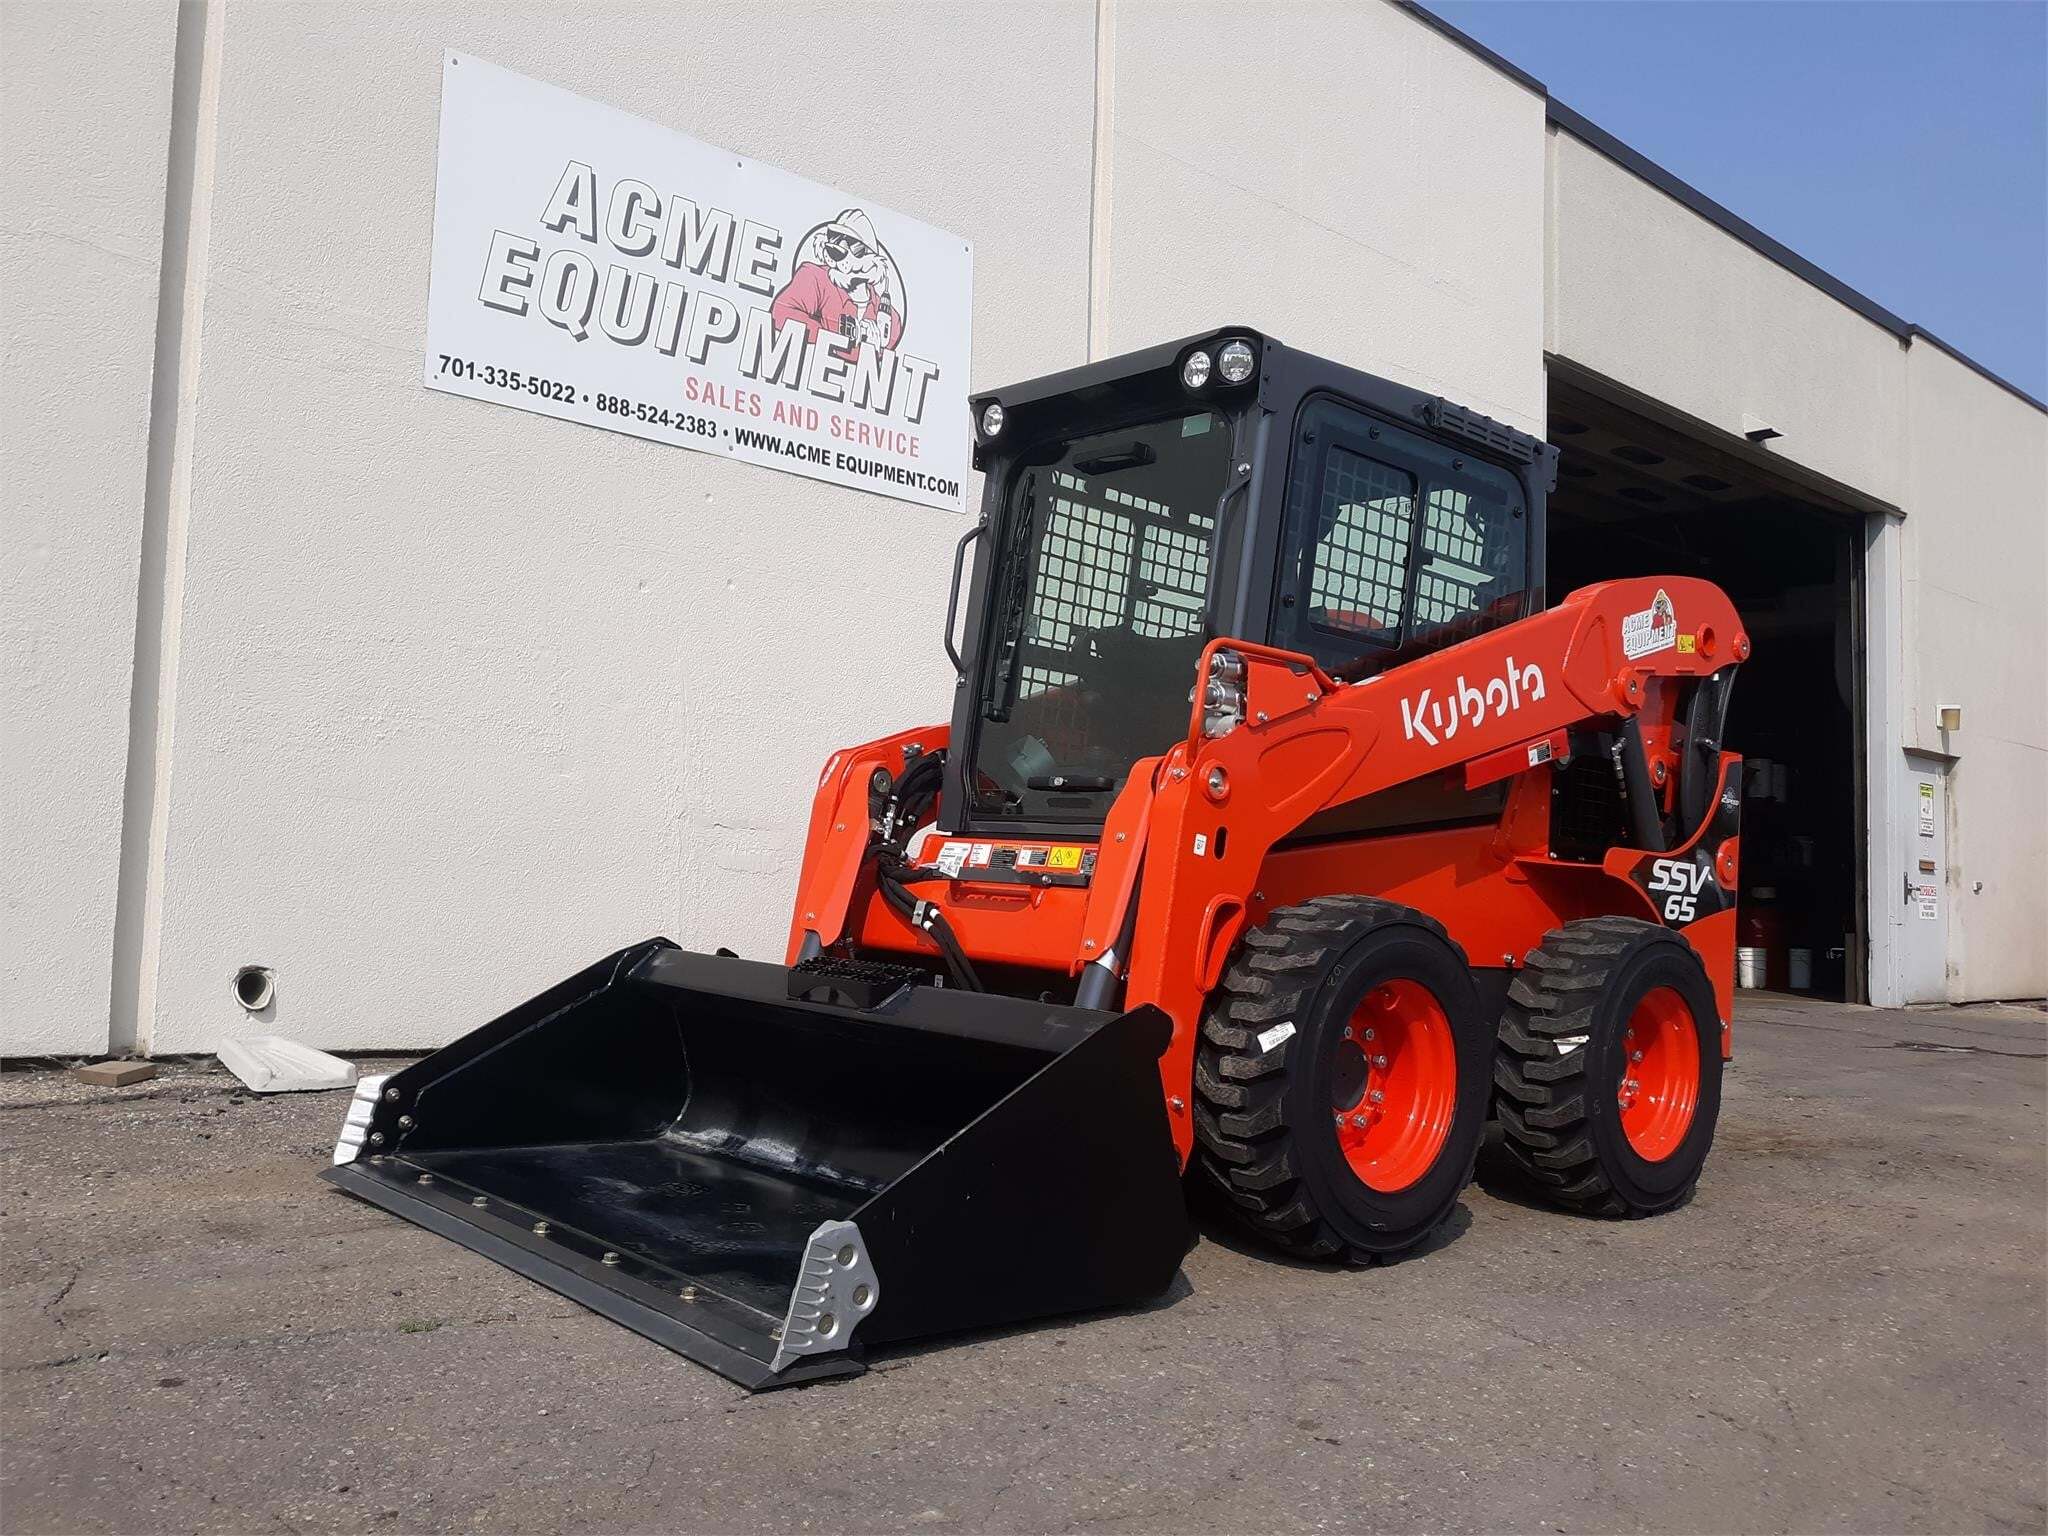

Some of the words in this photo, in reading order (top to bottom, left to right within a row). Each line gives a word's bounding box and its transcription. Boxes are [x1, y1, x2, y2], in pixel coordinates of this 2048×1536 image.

[540, 160, 783, 297] ACME
[478, 230, 939, 424] EQUIPMENT
[438, 354, 576, 404] 701-335-5022
[596, 393, 717, 438] 888-524-2383
[735, 427, 830, 466] WWW.ACME
[836, 456, 959, 497] EQUIPMENT.COM
[685, 376, 762, 417] SALES
[773, 400, 819, 431] AND
[830, 415, 920, 457] SERVICE
[1624, 613, 1650, 635] ACME
[1625, 623, 1675, 653] EQUIPMENT
[1401, 656, 1546, 746] Kubota
[1648, 859, 1710, 895] SSV
[1664, 895, 1698, 922] 65
